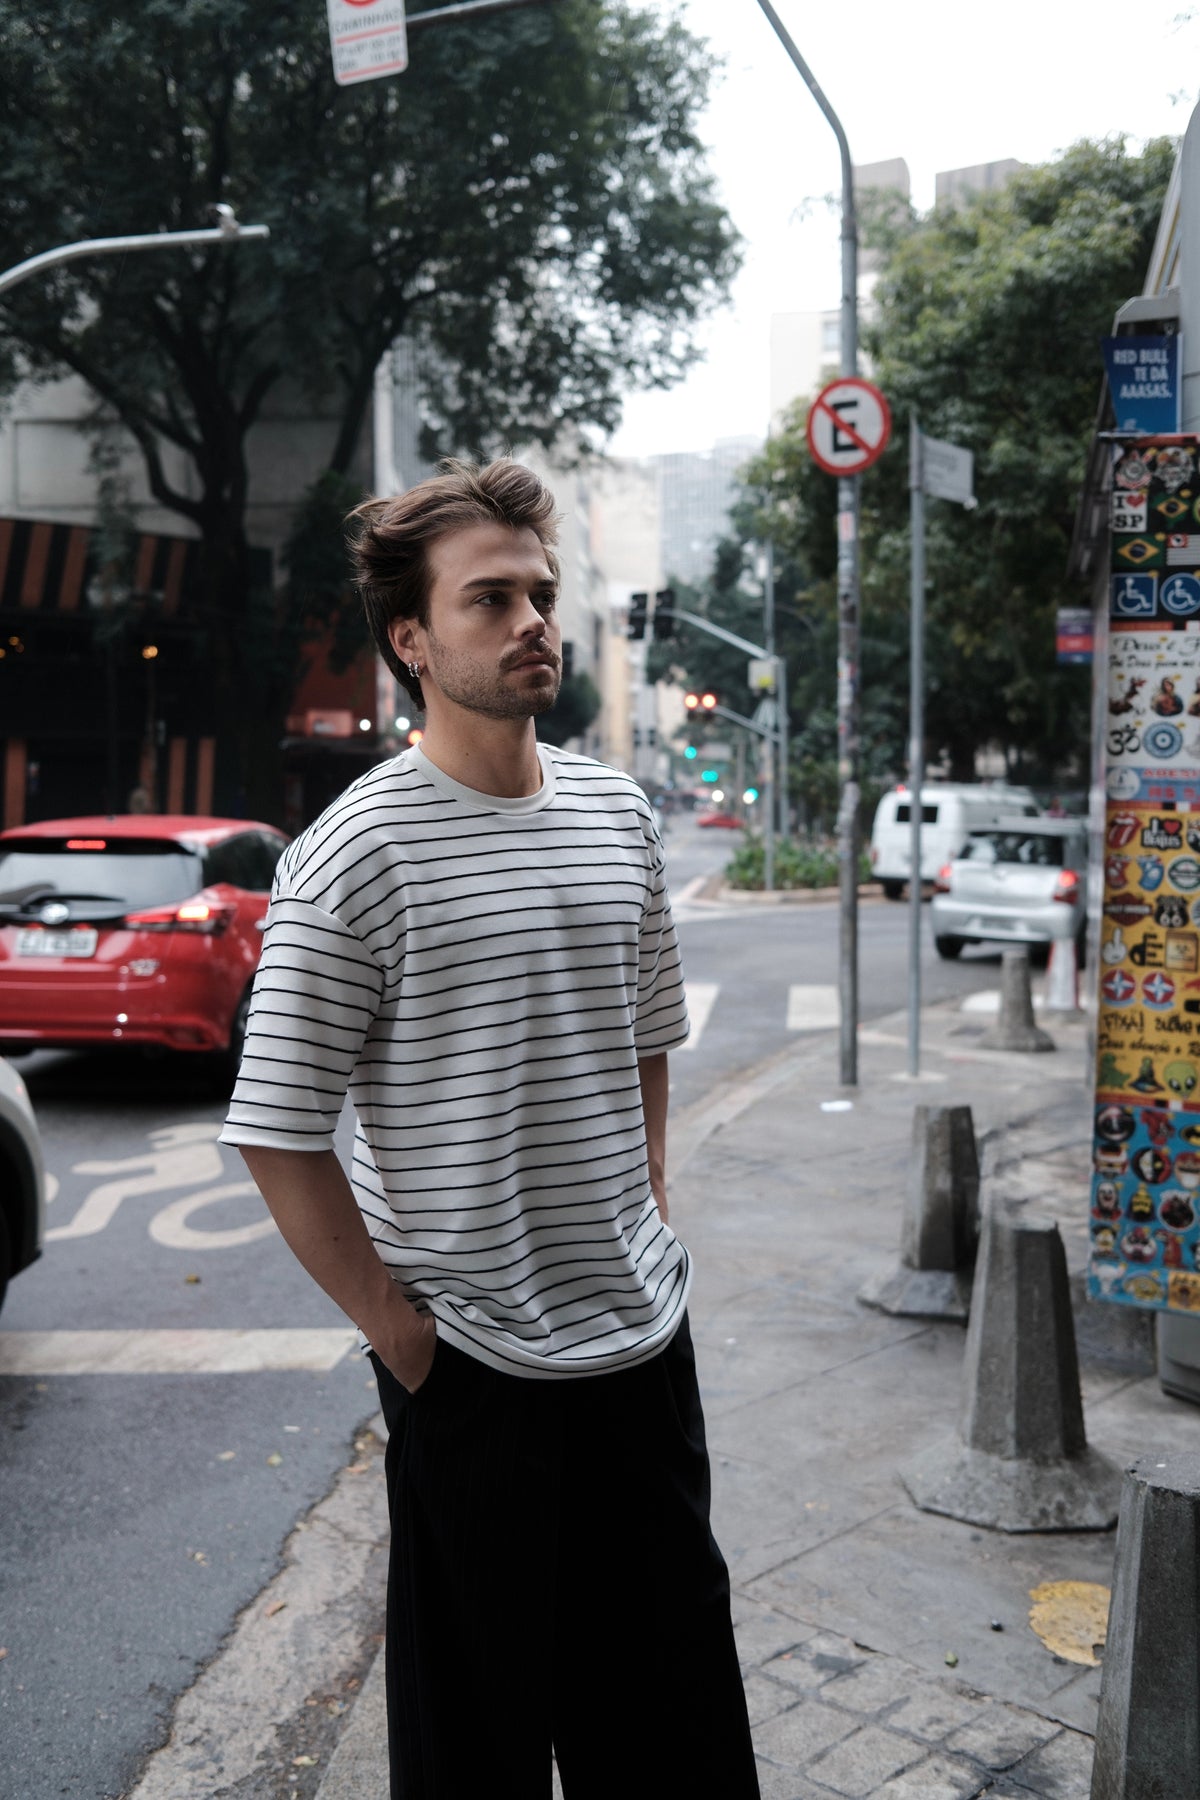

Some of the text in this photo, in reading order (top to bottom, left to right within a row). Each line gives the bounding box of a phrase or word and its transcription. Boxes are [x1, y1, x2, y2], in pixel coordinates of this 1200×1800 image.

[1113, 349, 1169, 365] RED BULL
[1134, 366, 1147, 382] TE
[832, 400, 861, 453] E
[1115, 495, 1124, 509] I
[1114, 514, 1143, 529] SP
